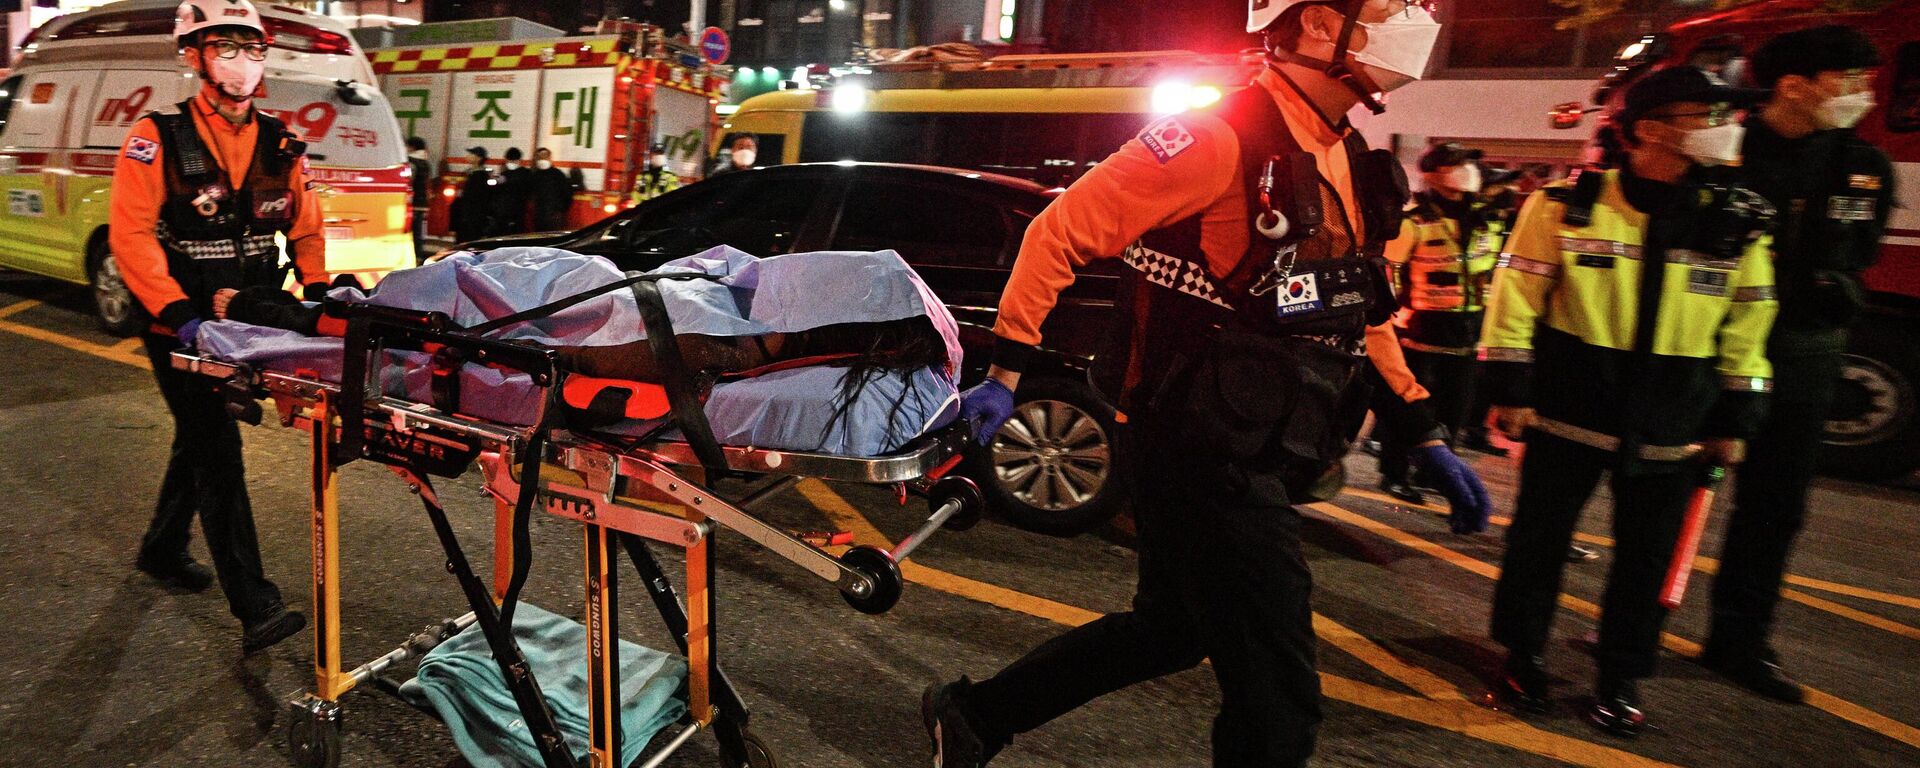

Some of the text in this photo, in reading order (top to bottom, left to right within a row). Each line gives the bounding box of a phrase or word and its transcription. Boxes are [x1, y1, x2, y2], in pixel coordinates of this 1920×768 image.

[94, 86, 153, 127] 119
[1143, 135, 1165, 158] KOREA
[1282, 302, 1316, 314] KOREA
[591, 594, 601, 657] SUNGWOO
